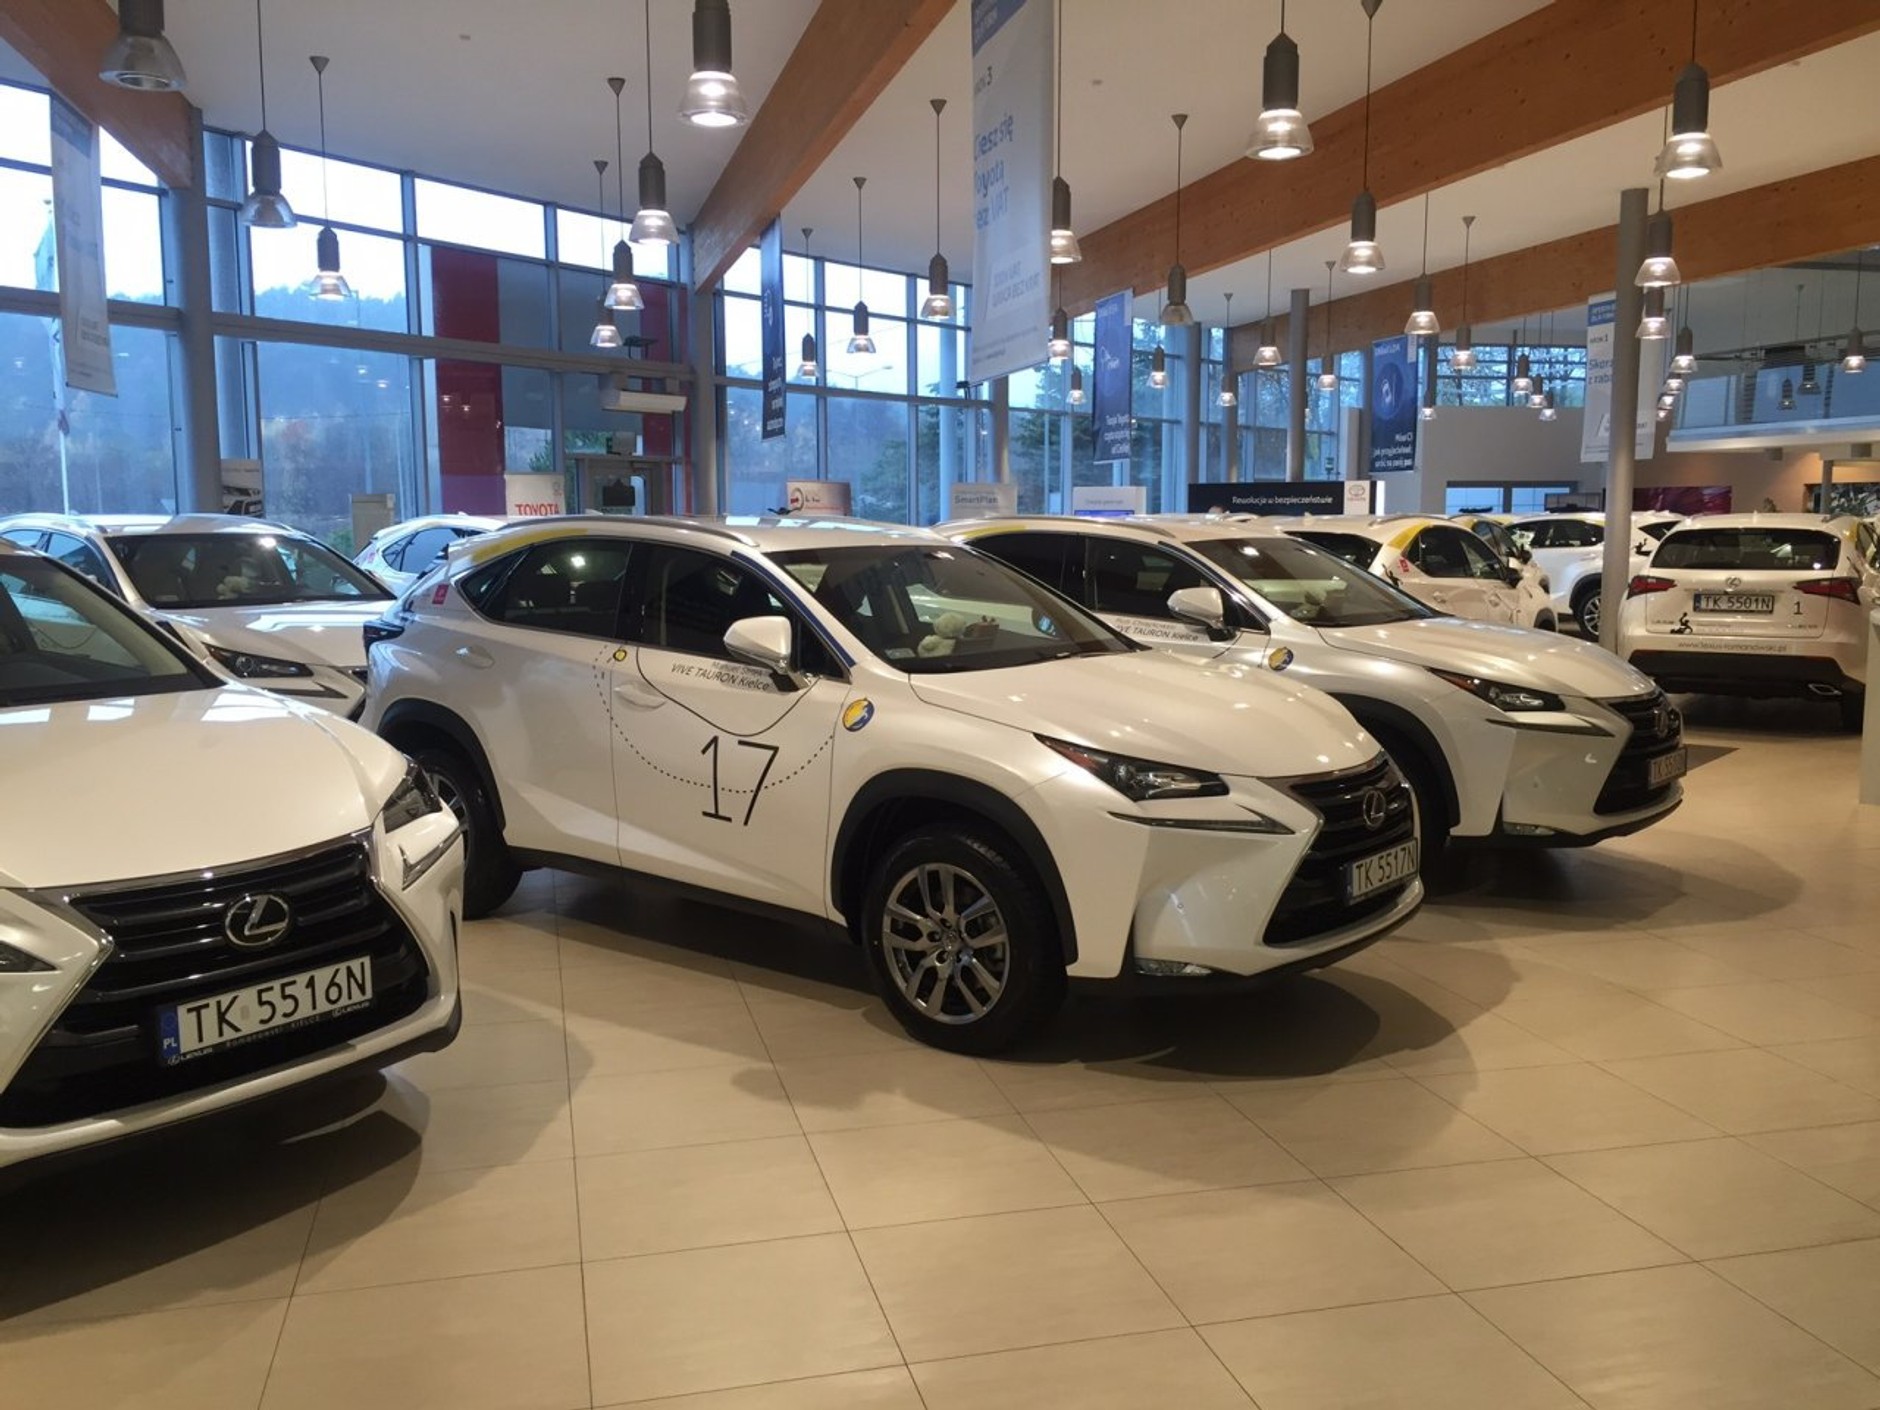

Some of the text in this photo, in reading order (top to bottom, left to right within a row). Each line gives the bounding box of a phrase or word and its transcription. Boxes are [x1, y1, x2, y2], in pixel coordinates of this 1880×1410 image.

[954, 494, 998, 505] SmartPlan
[1232, 496, 1266, 506] Rewolucja
[514, 503, 560, 516] TOYOTA
[1703, 595, 1771, 610] TK 5501N
[1793, 601, 1803, 616] 1
[1132, 626, 1170, 638] TAURON
[671, 664, 694, 676] VIVE
[694, 667, 739, 684] TAURON
[739, 677, 770, 691] Kielce
[701, 735, 780, 827] 17
[1355, 845, 1415, 893] TK 5517N
[186, 961, 367, 1044] TK 5516N
[163, 1037, 178, 1050] PL
